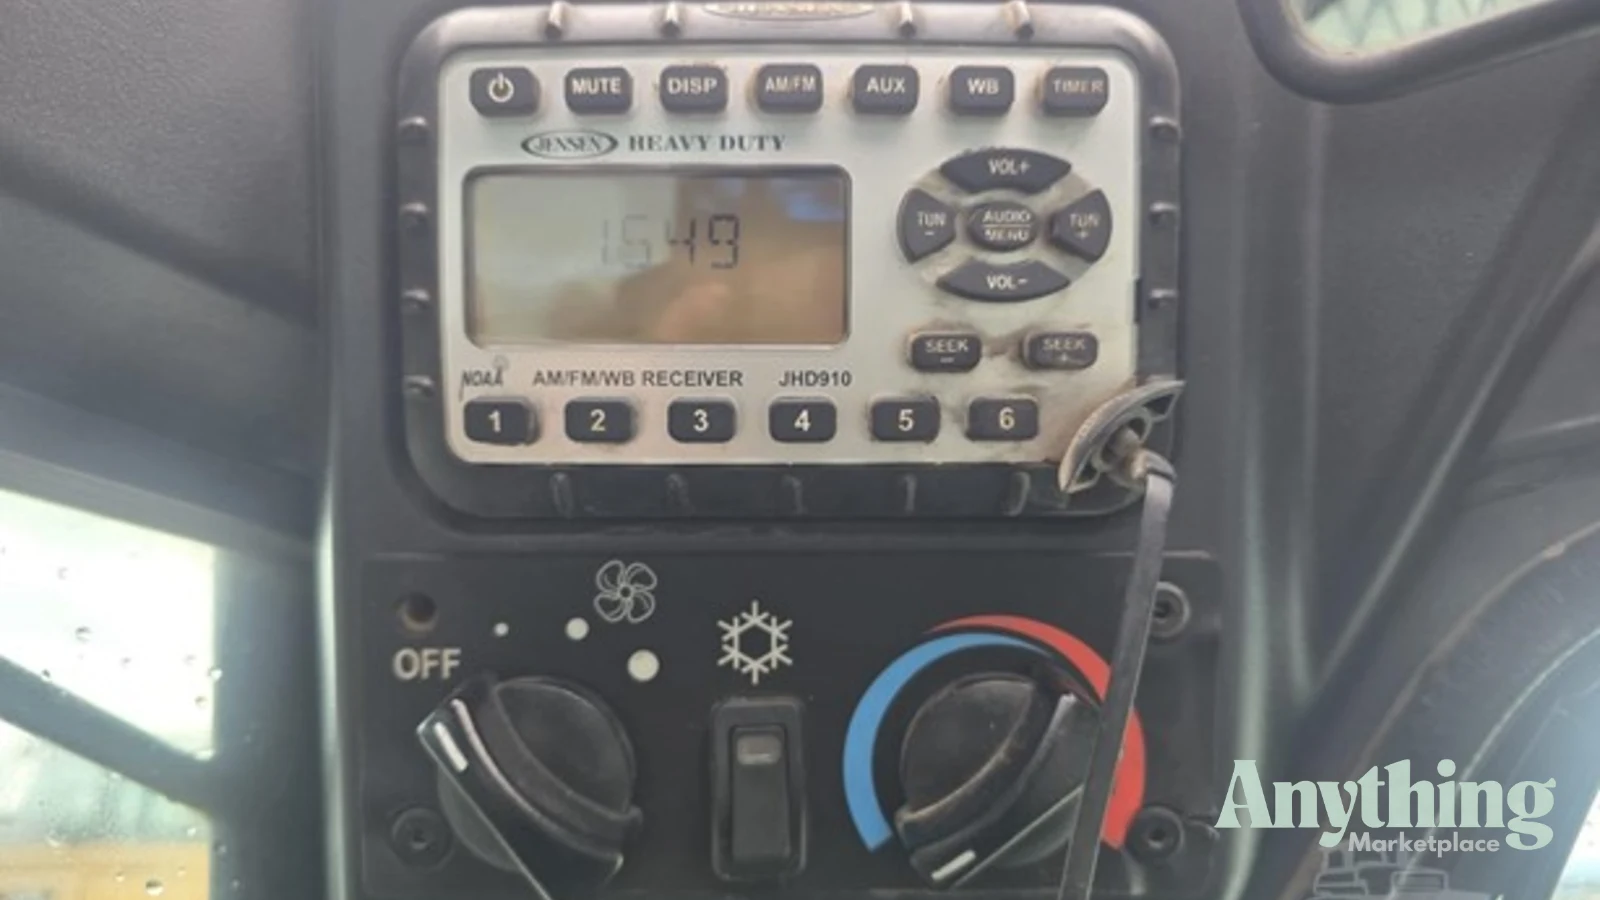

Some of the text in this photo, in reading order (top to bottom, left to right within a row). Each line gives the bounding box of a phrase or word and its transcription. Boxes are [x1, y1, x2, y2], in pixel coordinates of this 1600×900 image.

[571, 76, 622, 96] MUTE
[667, 76, 718, 95] DISP
[764, 74, 816, 93] AM/FM
[866, 77, 906, 95] AUX
[966, 78, 999, 96] WB
[1052, 77, 1105, 95] TIMER
[533, 134, 787, 152] JENSEN HEAVY DUTY
[916, 212, 946, 228] TUN
[983, 209, 1031, 223] AUDIO
[1070, 212, 1099, 228] TUN
[983, 228, 1031, 243] MENU
[925, 340, 970, 354] SEEK
[1042, 338, 1087, 352] SEEK
[461, 369, 504, 388] NOAA
[532, 369, 744, 388] AM/FM/WB RECEIVER
[777, 369, 852, 388] JHD910
[487, 410, 502, 432] 1
[590, 409, 606, 431] 2
[692, 409, 709, 431] 3
[793, 408, 811, 432] 4
[898, 410, 914, 431] 5
[999, 408, 1016, 430] 6
[392, 647, 462, 681] OFF
